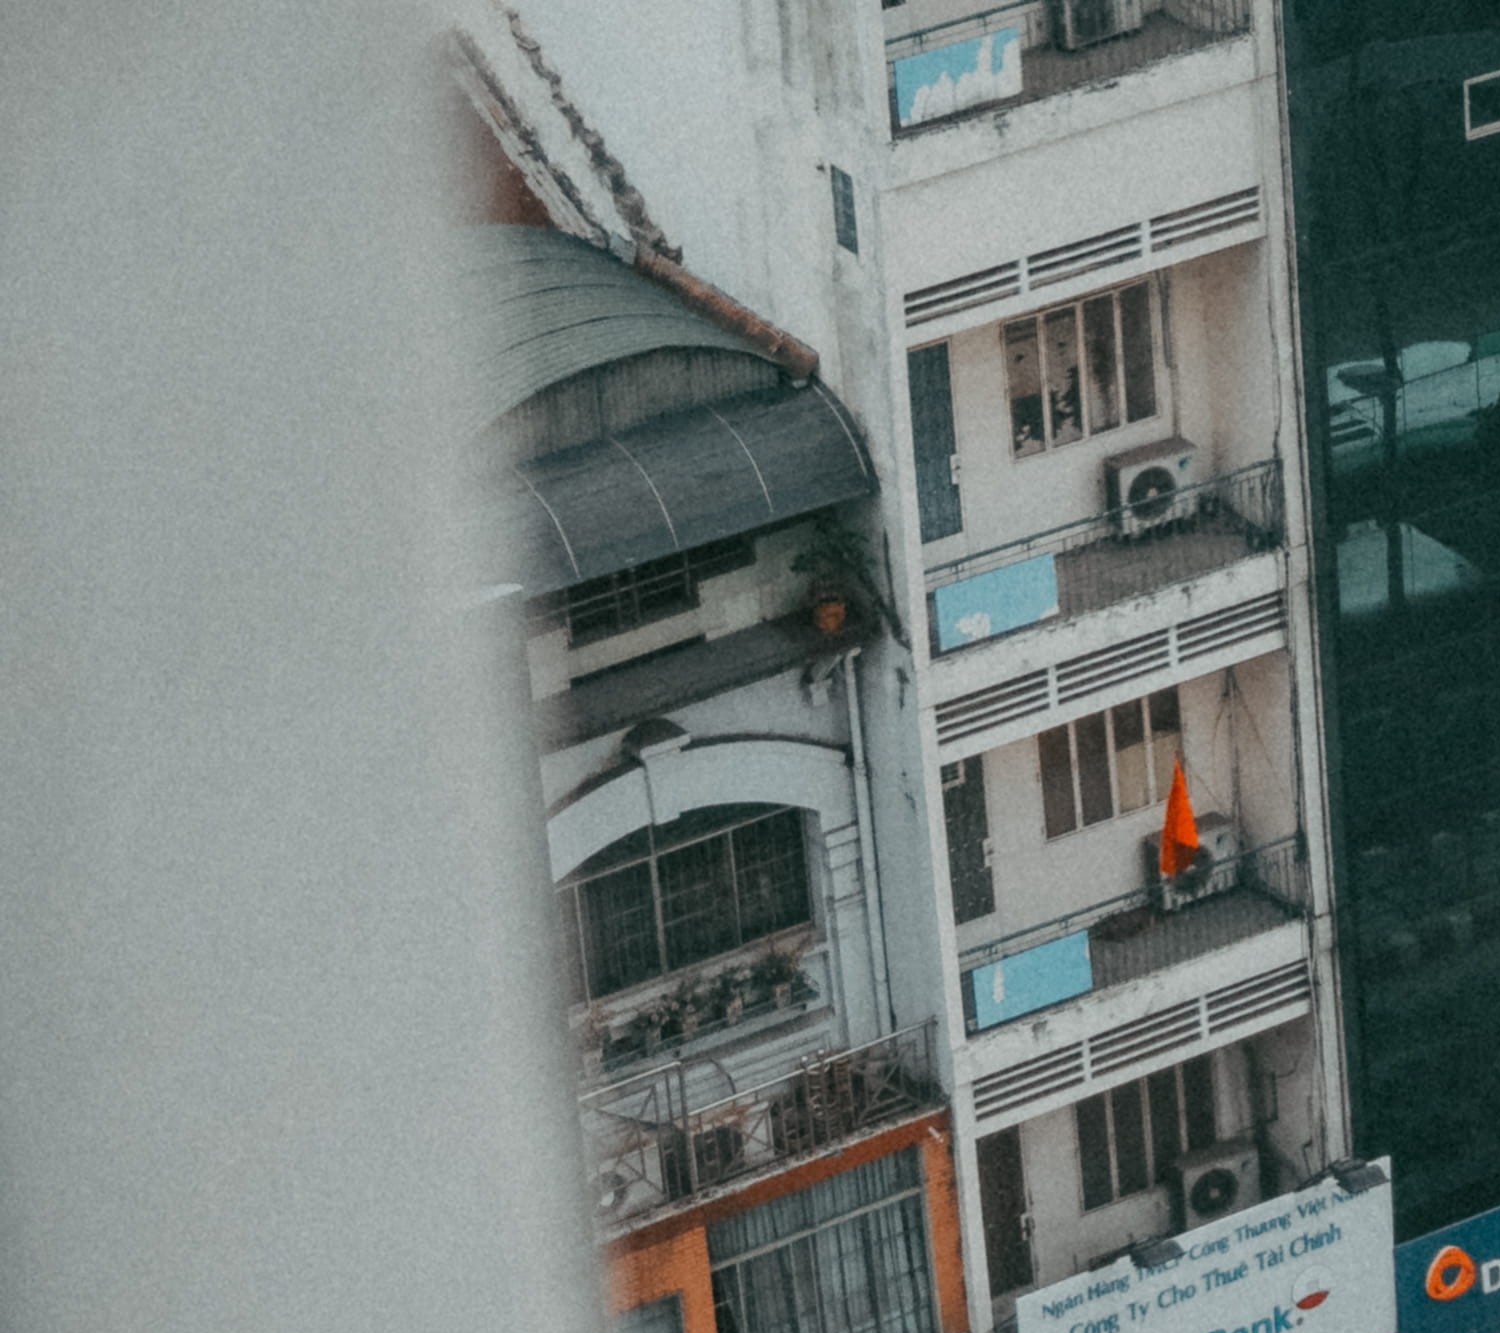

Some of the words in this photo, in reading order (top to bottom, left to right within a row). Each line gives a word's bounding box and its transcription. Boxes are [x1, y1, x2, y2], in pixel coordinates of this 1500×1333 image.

[1042, 1292, 1084, 1319] Ngân
[1087, 1275, 1131, 1301] Hàng
[1188, 1236, 1230, 1261] Công
[1157, 1284, 1197, 1309] Cho
[1202, 1260, 1248, 1292] Thuê
[1255, 1244, 1284, 1271] Tài
[1290, 1223, 1342, 1258] Chính
